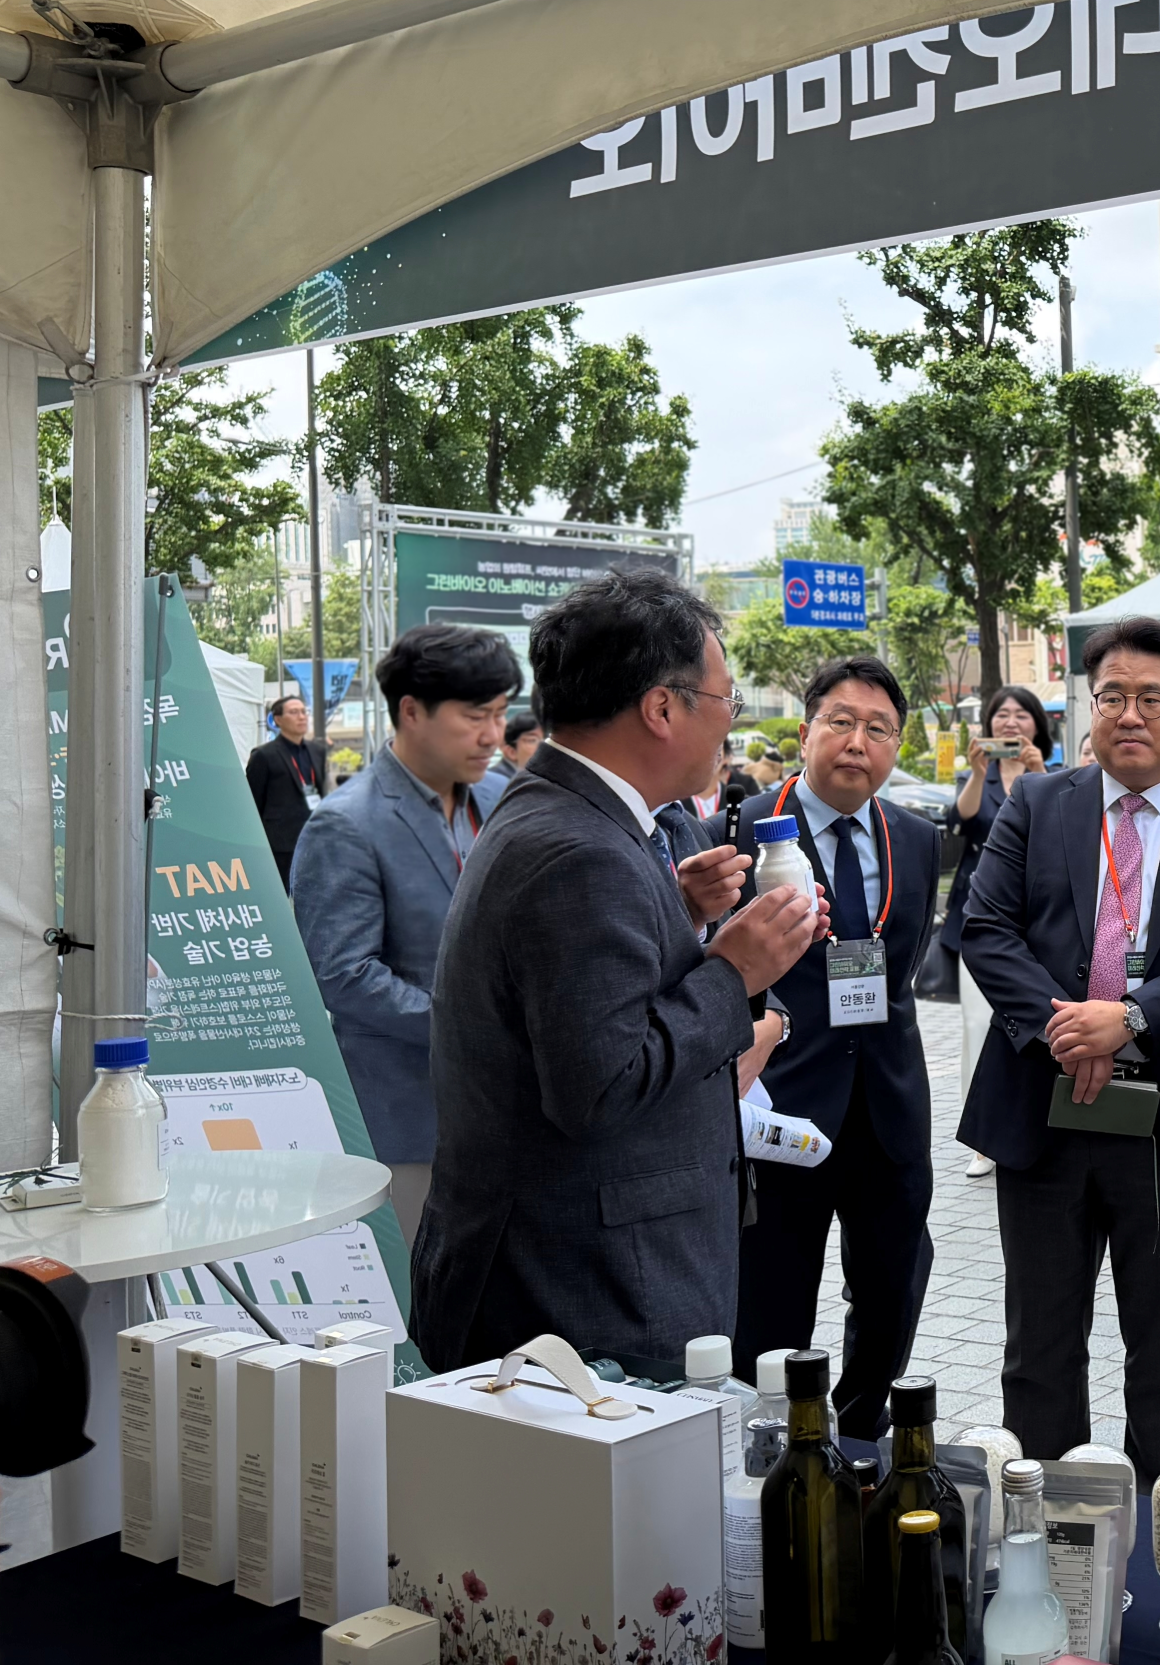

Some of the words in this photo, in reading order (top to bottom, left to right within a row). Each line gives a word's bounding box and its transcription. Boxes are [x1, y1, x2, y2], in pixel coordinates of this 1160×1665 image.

[426, 573, 486, 593] 그린바이오
[488, 578, 547, 596] 이노베이션
[813, 568, 860, 586] 관광버스
[840, 992, 876, 1007] 안동환
